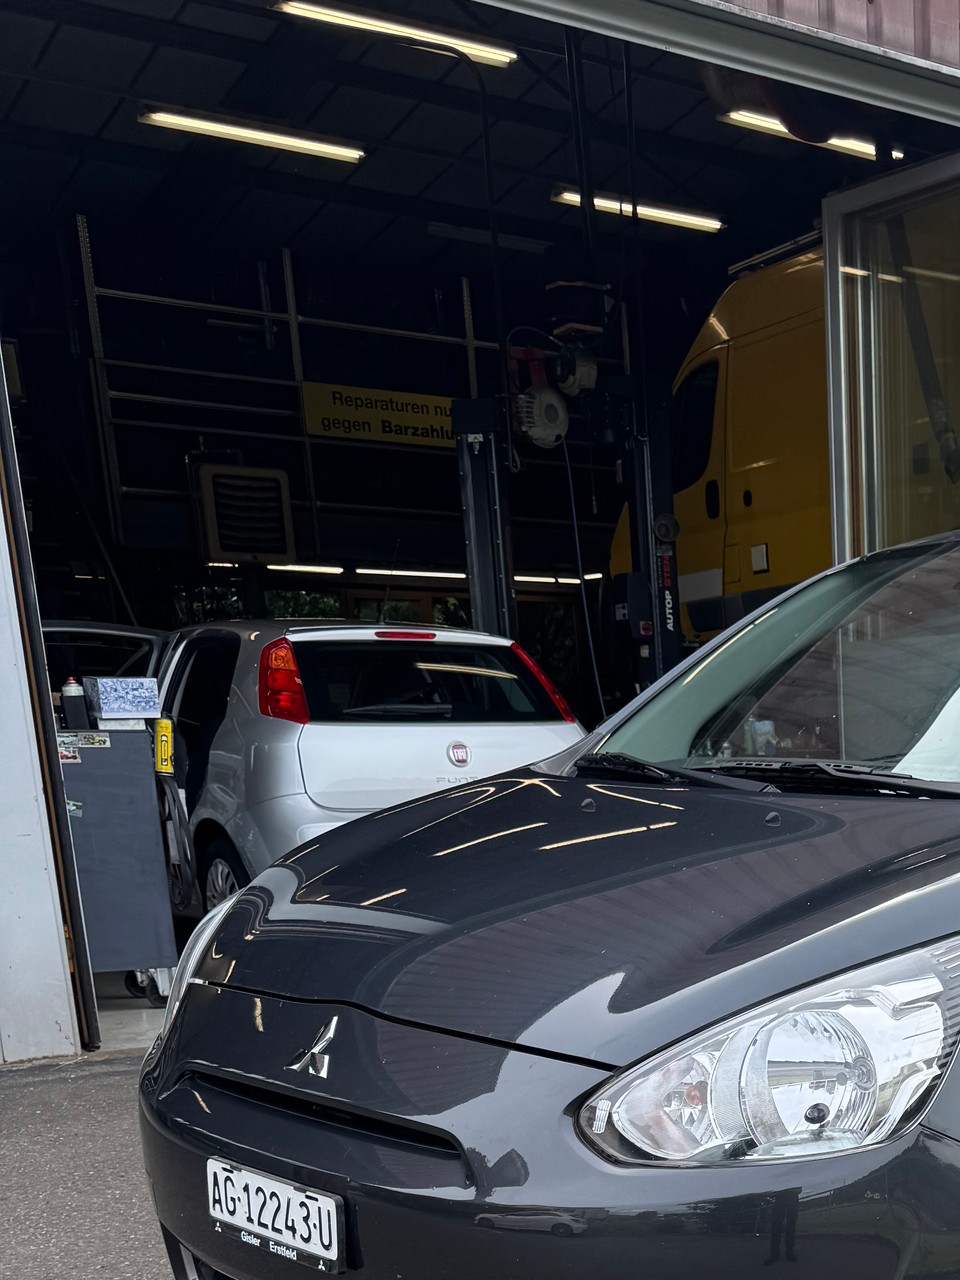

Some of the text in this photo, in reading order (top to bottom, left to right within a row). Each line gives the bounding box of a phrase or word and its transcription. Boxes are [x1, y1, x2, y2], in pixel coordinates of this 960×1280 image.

[331, 390, 430, 415] Reparaturen
[321, 416, 371, 434] gegen
[665, 590, 674, 631] AUTOP
[453, 748, 467, 760] FIAT
[241, 1231, 297, 1260] Gisler Erstfeld
